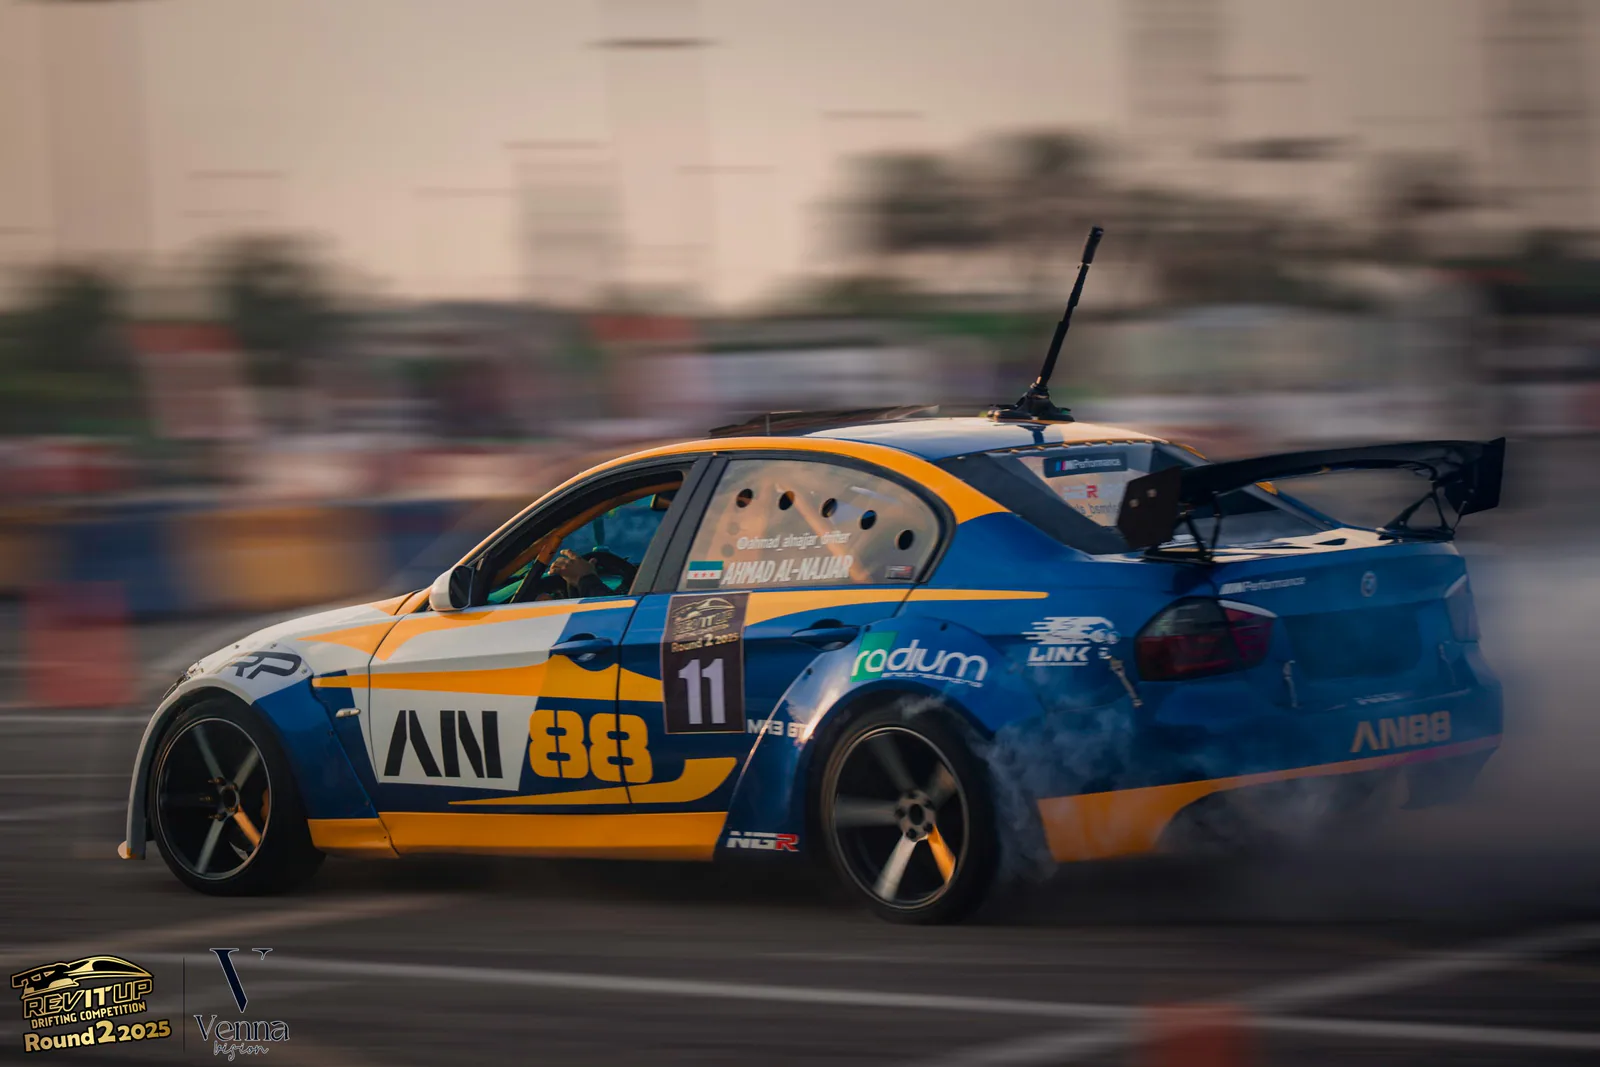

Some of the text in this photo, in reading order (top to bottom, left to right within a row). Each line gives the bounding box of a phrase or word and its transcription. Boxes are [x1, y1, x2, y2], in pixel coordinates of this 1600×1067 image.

[722, 560, 775, 585] AHMAD
[776, 555, 853, 582] AL-NAJJAR
[671, 638, 703, 653] Round
[704, 633, 714, 646] 2
[715, 632, 740, 645] 2025
[851, 639, 988, 681] radium
[1028, 646, 1092, 662] LINK
[679, 658, 726, 725] 11
[529, 709, 653, 783] 88
[1350, 711, 1452, 753] AN88
[726, 830, 800, 852] NGR
